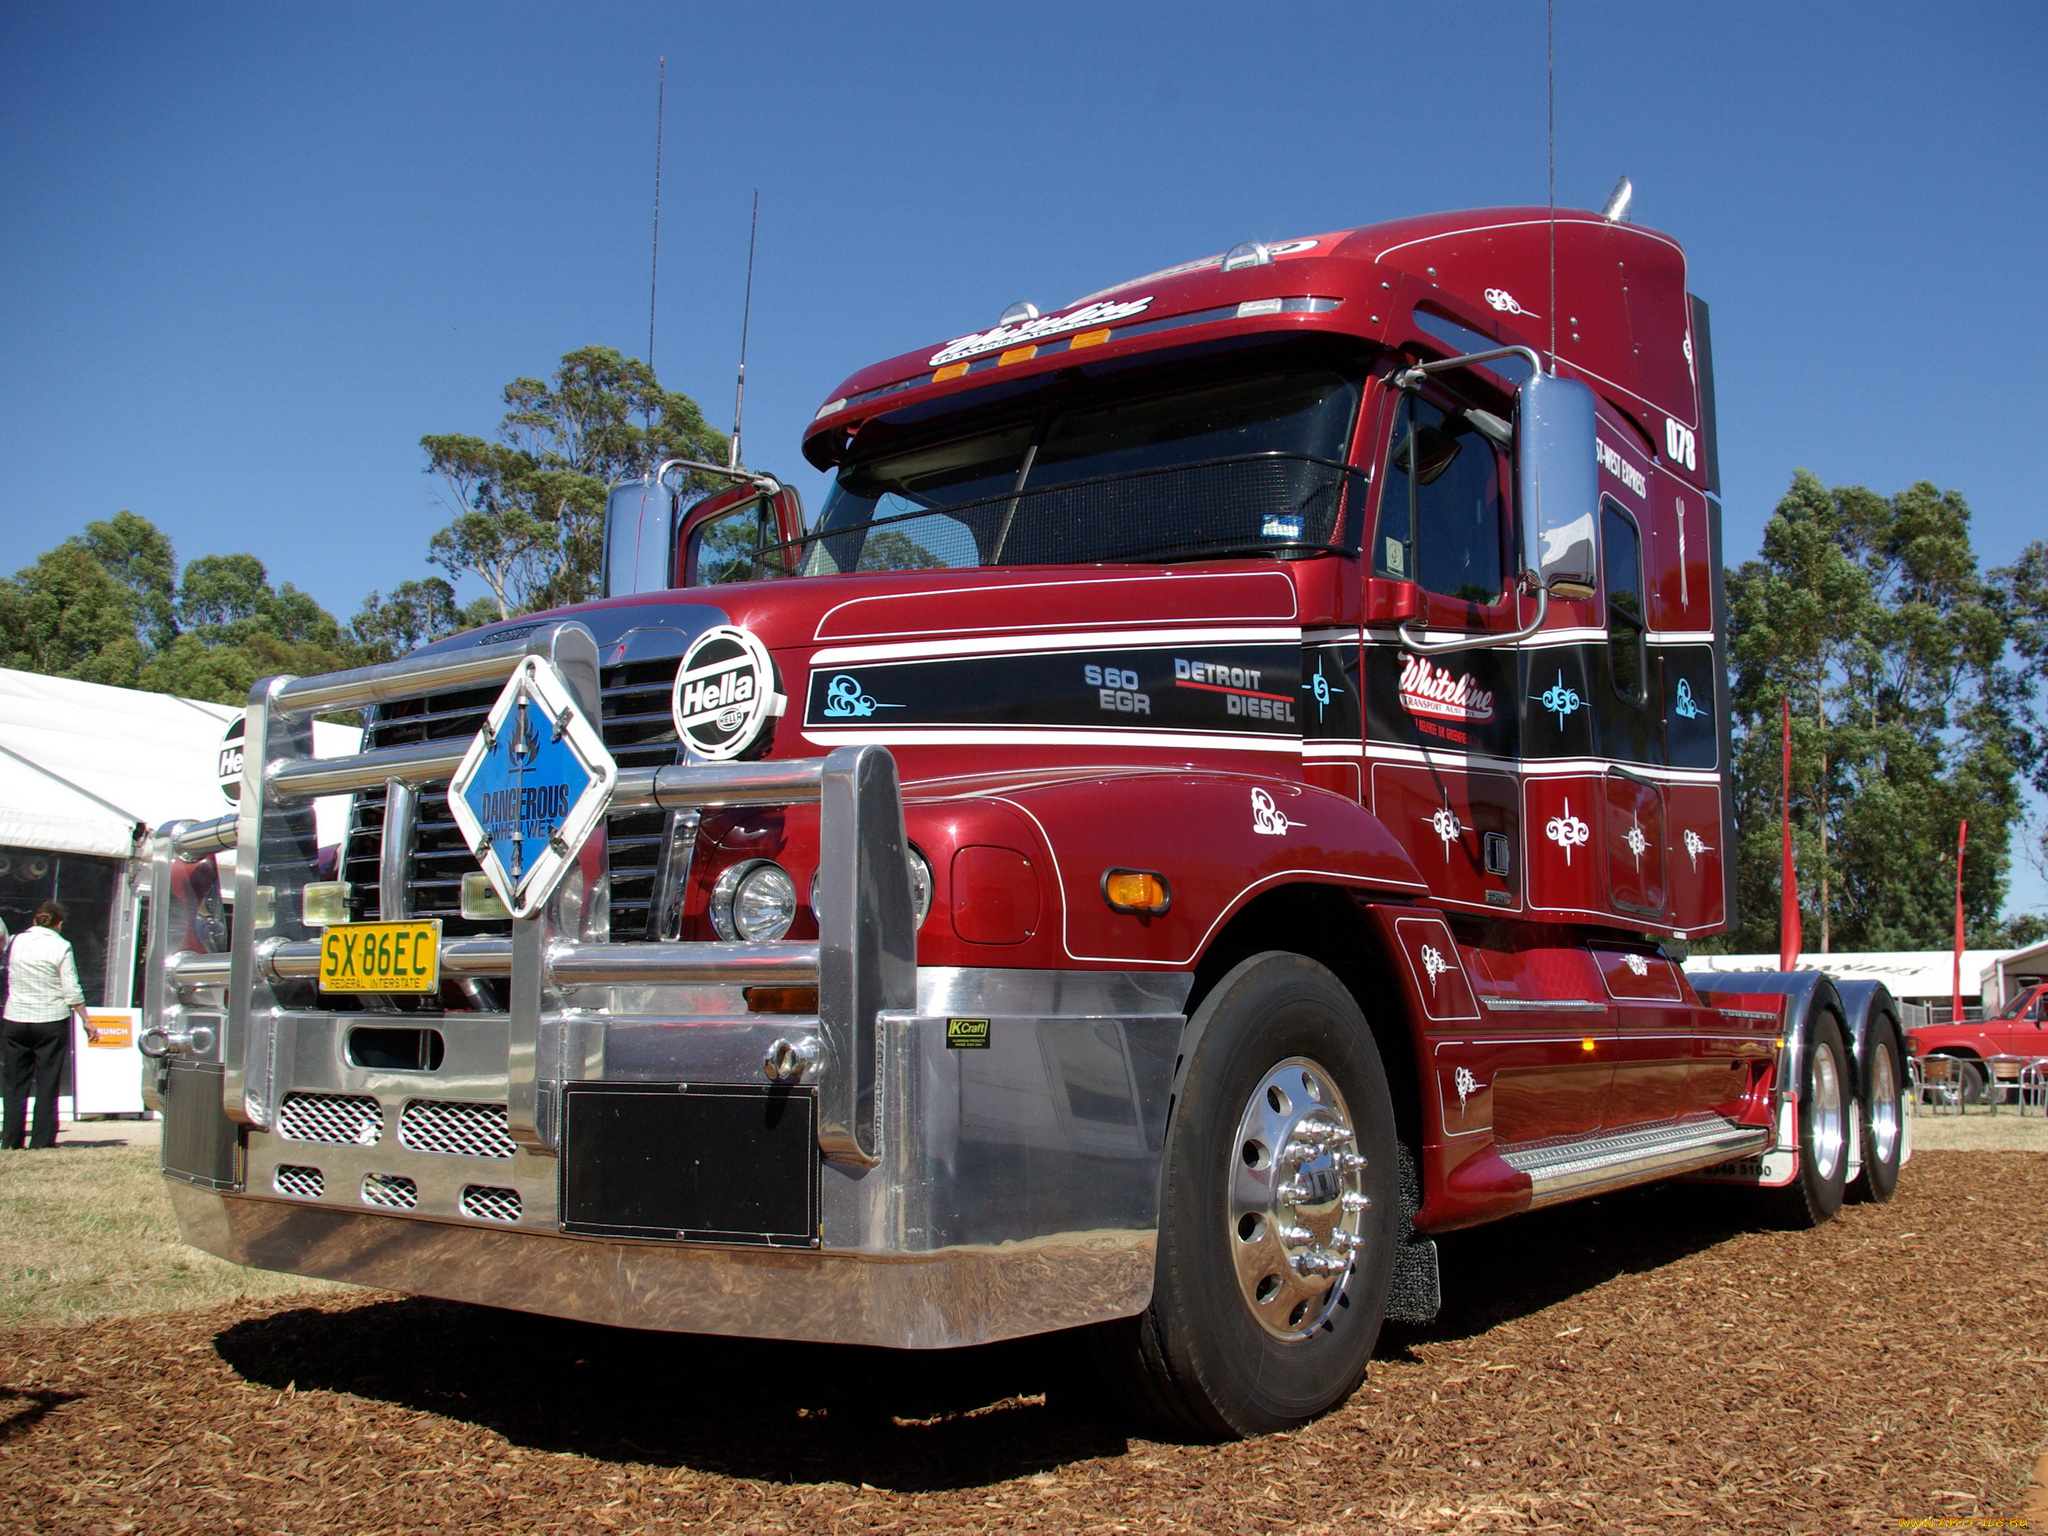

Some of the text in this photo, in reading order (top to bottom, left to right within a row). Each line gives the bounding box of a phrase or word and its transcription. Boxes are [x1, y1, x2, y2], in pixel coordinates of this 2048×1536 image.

[1596, 436, 1621, 479] ST-WEST
[1665, 417, 1696, 472] 078
[1174, 657, 1262, 690] DETROIT
[1398, 651, 1493, 716] Whiteline
[682, 670, 754, 717] Hella
[1099, 688, 1151, 715] EGR
[1226, 693, 1296, 723] DIESEL
[1402, 694, 1442, 712] TRANSPORT
[482, 784, 569, 825] DANGEROUS
[330, 977, 421, 989] FEDERAL INTERSTATE
[97, 1027, 129, 1036] RUNCH
[951, 1021, 985, 1035] KCraft
[1740, 1163, 1772, 1177] 5100
